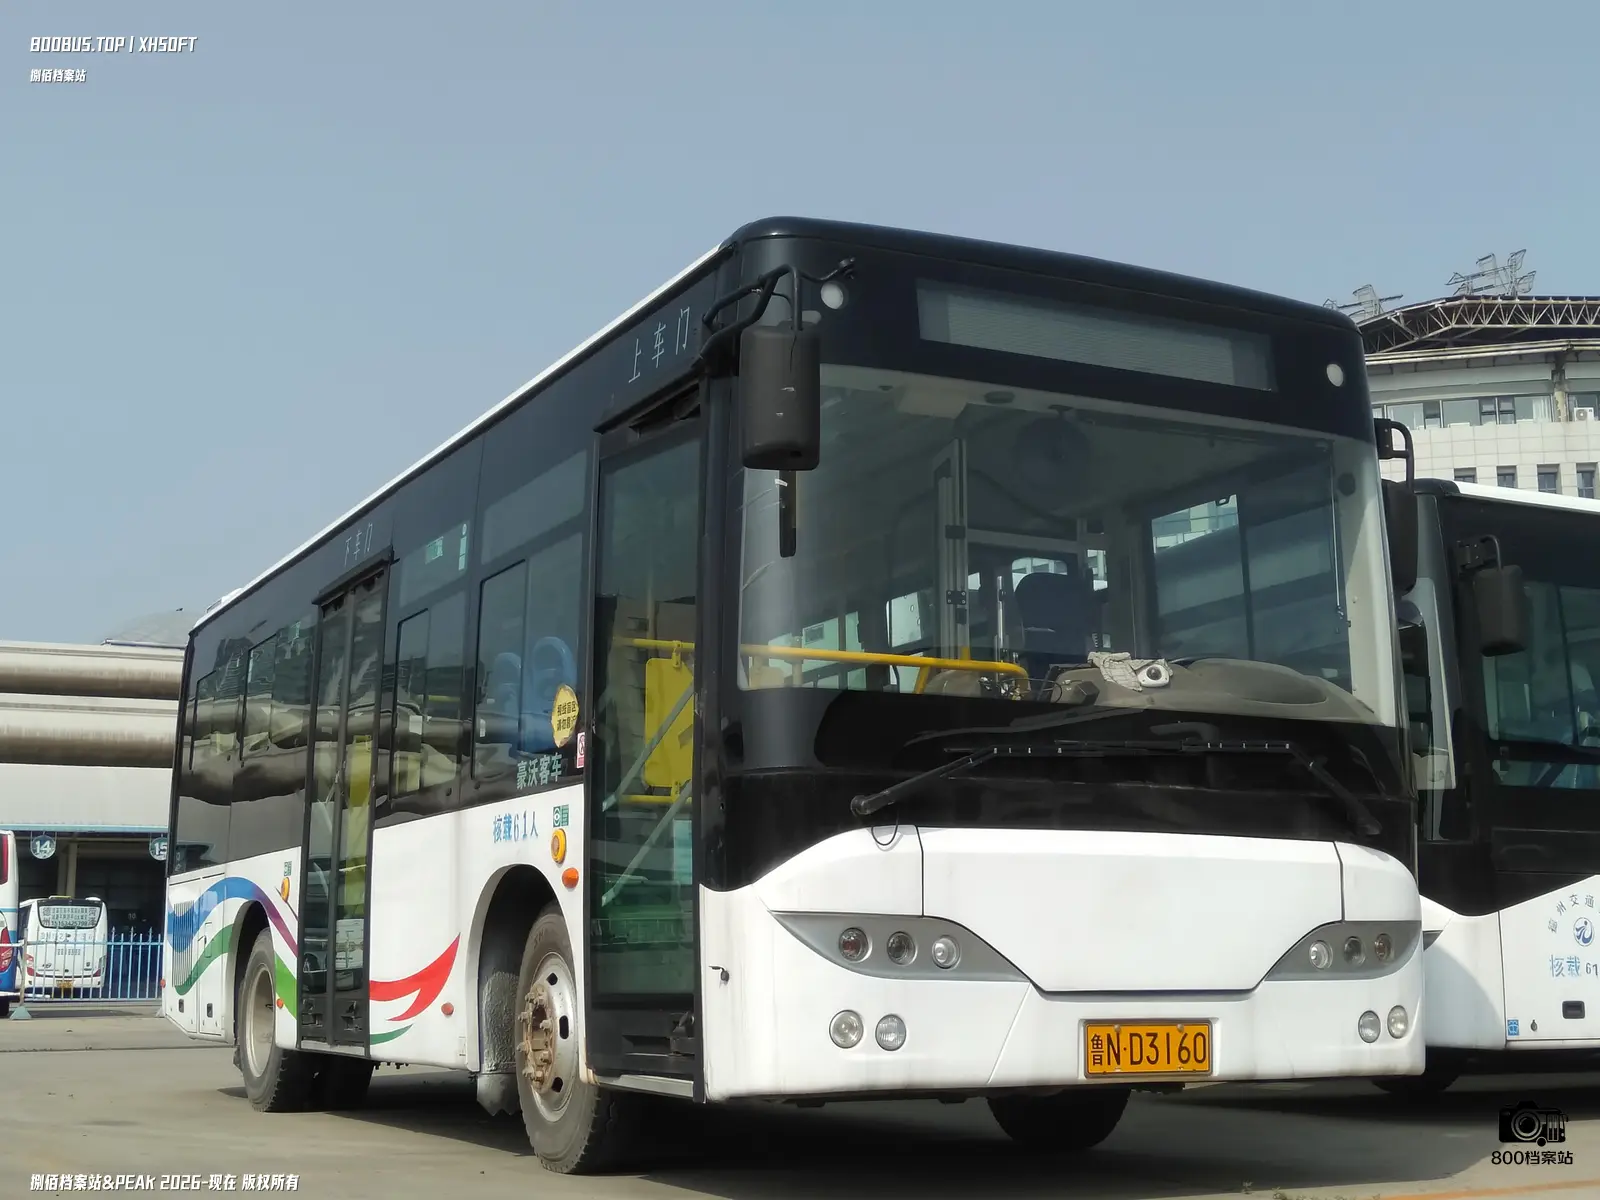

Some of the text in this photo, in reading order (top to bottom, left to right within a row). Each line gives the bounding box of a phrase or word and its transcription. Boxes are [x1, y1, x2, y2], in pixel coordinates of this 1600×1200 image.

[628, 306, 691, 384] 上车门
[343, 522, 373, 567] 下车门
[516, 752, 563, 790] 豪沃客车
[493, 810, 538, 843] 核载61人
[35, 840, 51, 854] 14
[154, 842, 168, 856] 15
[1547, 894, 1600, 933] 德州交通
[1090, 1031, 1207, 1067] 鲁N·D3160
